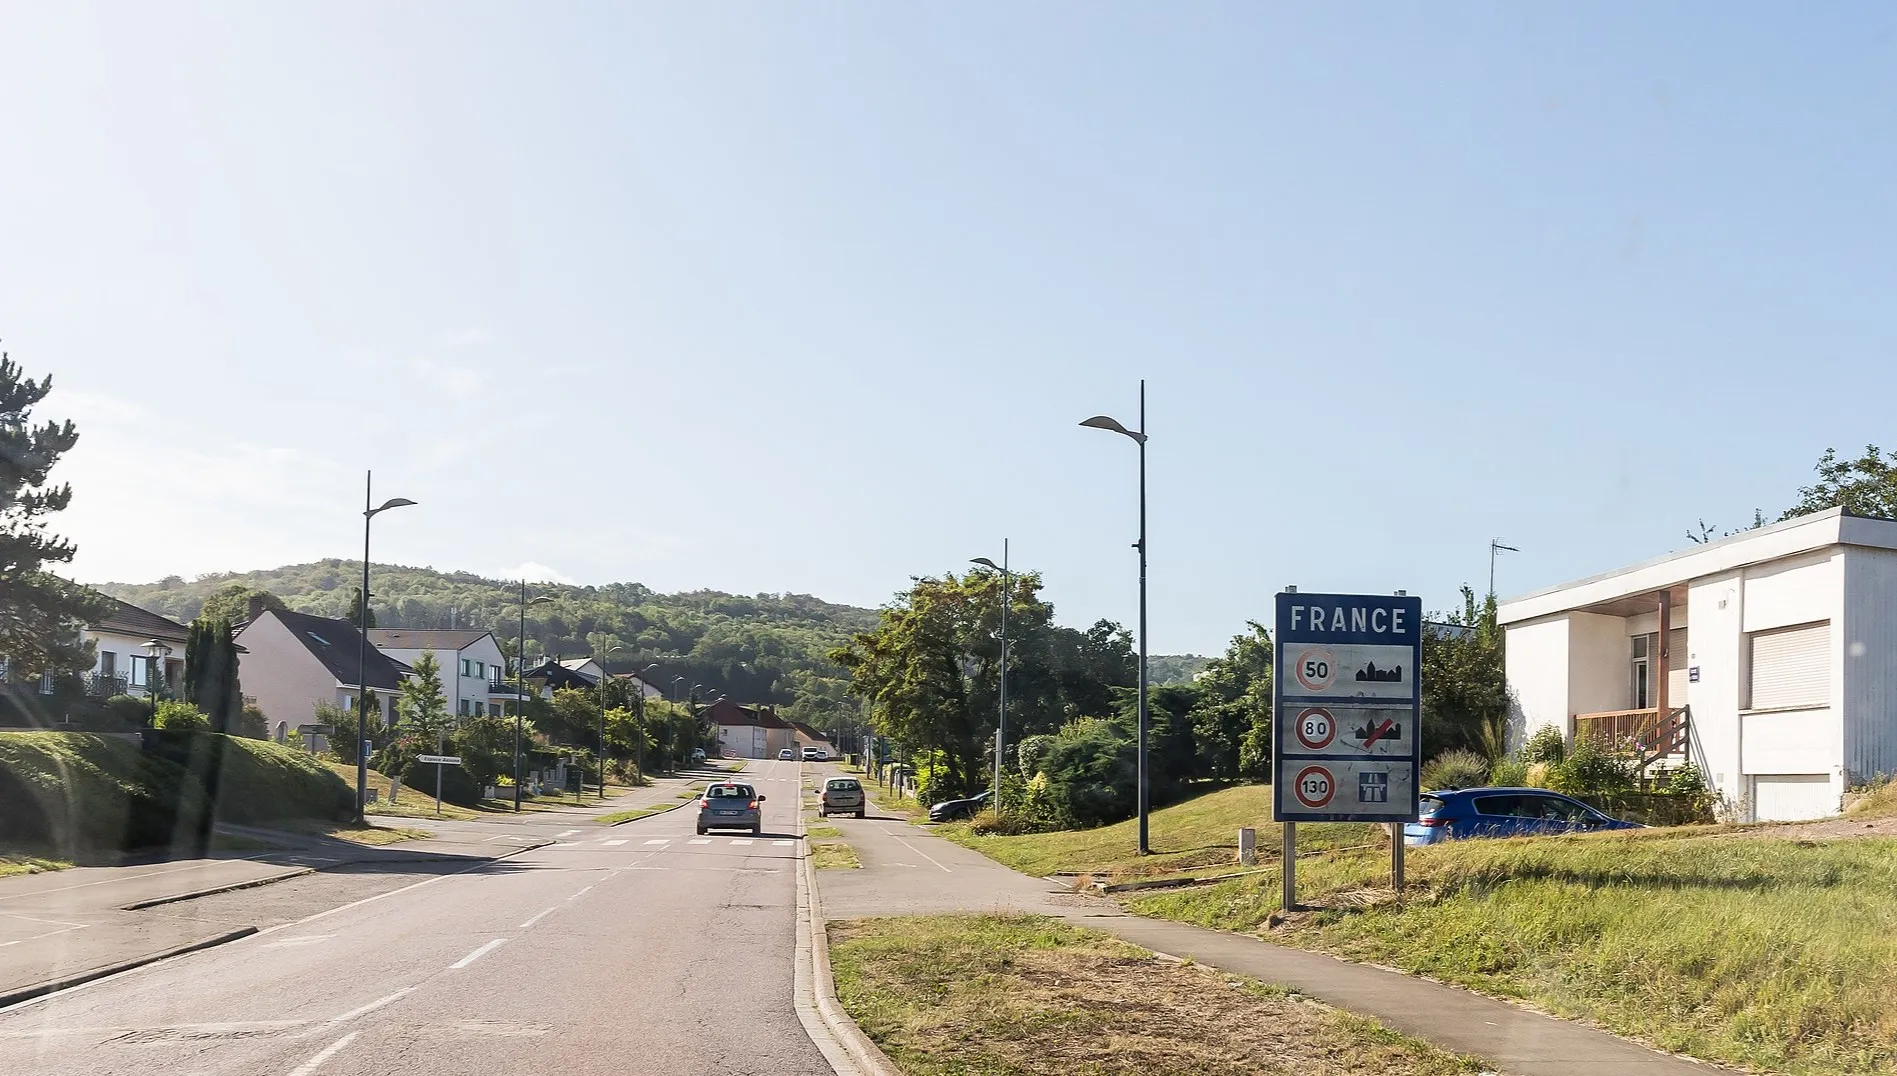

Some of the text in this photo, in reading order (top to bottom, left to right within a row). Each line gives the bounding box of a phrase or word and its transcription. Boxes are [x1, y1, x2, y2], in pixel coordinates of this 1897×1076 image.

[1291, 605, 1406, 634] FRANCE
[1305, 661, 1328, 679] 50
[1305, 722, 1327, 735] 80
[1302, 780, 1328, 794] 130
